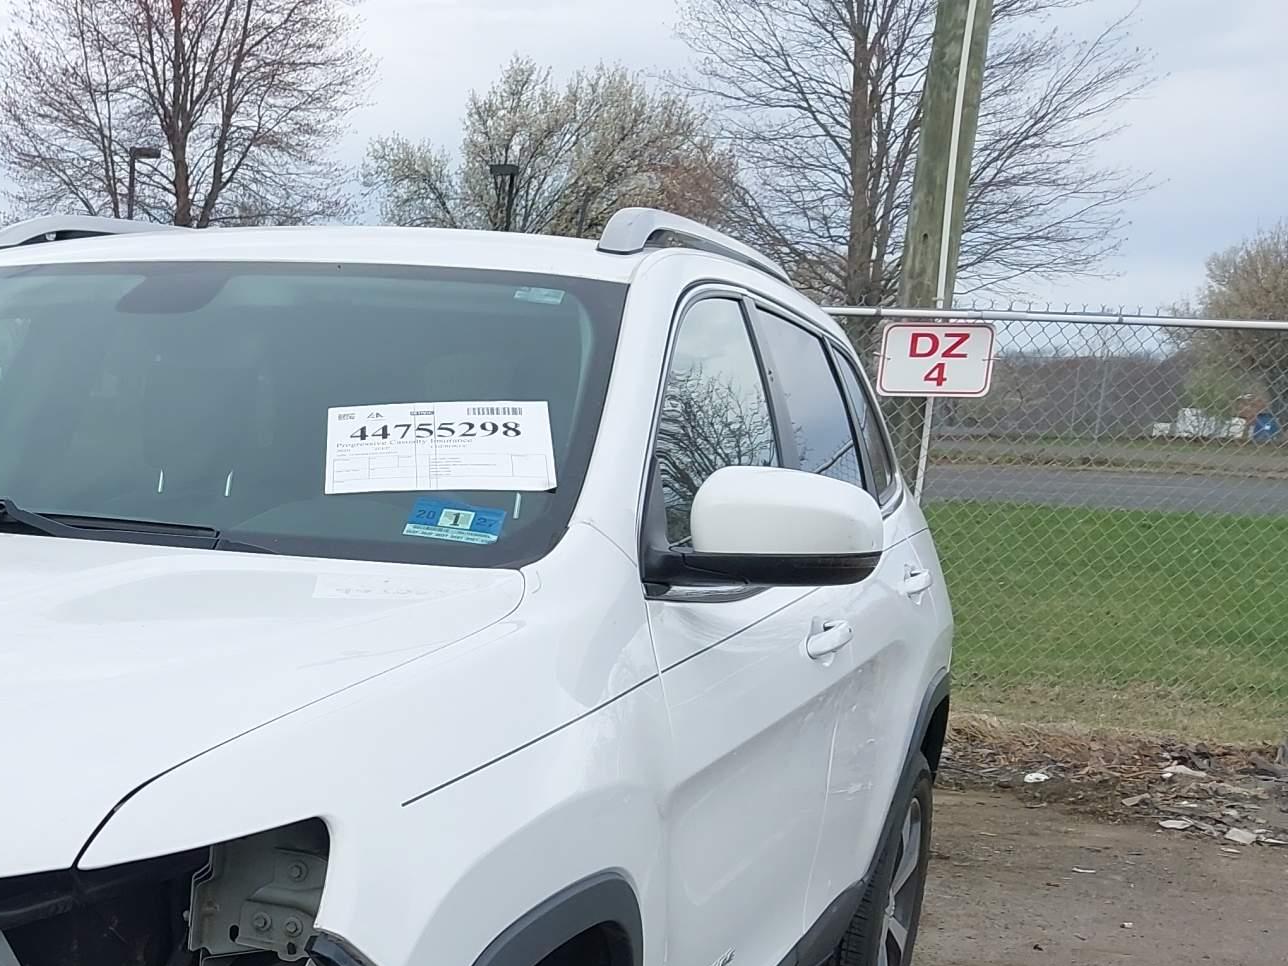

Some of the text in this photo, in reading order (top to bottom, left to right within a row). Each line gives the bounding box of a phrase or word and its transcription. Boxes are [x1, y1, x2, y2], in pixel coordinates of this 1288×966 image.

[908, 332, 971, 359] DZ
[923, 362, 947, 387] 4
[349, 420, 521, 441] 44755298
[415, 509, 497, 528] 20 1 27
